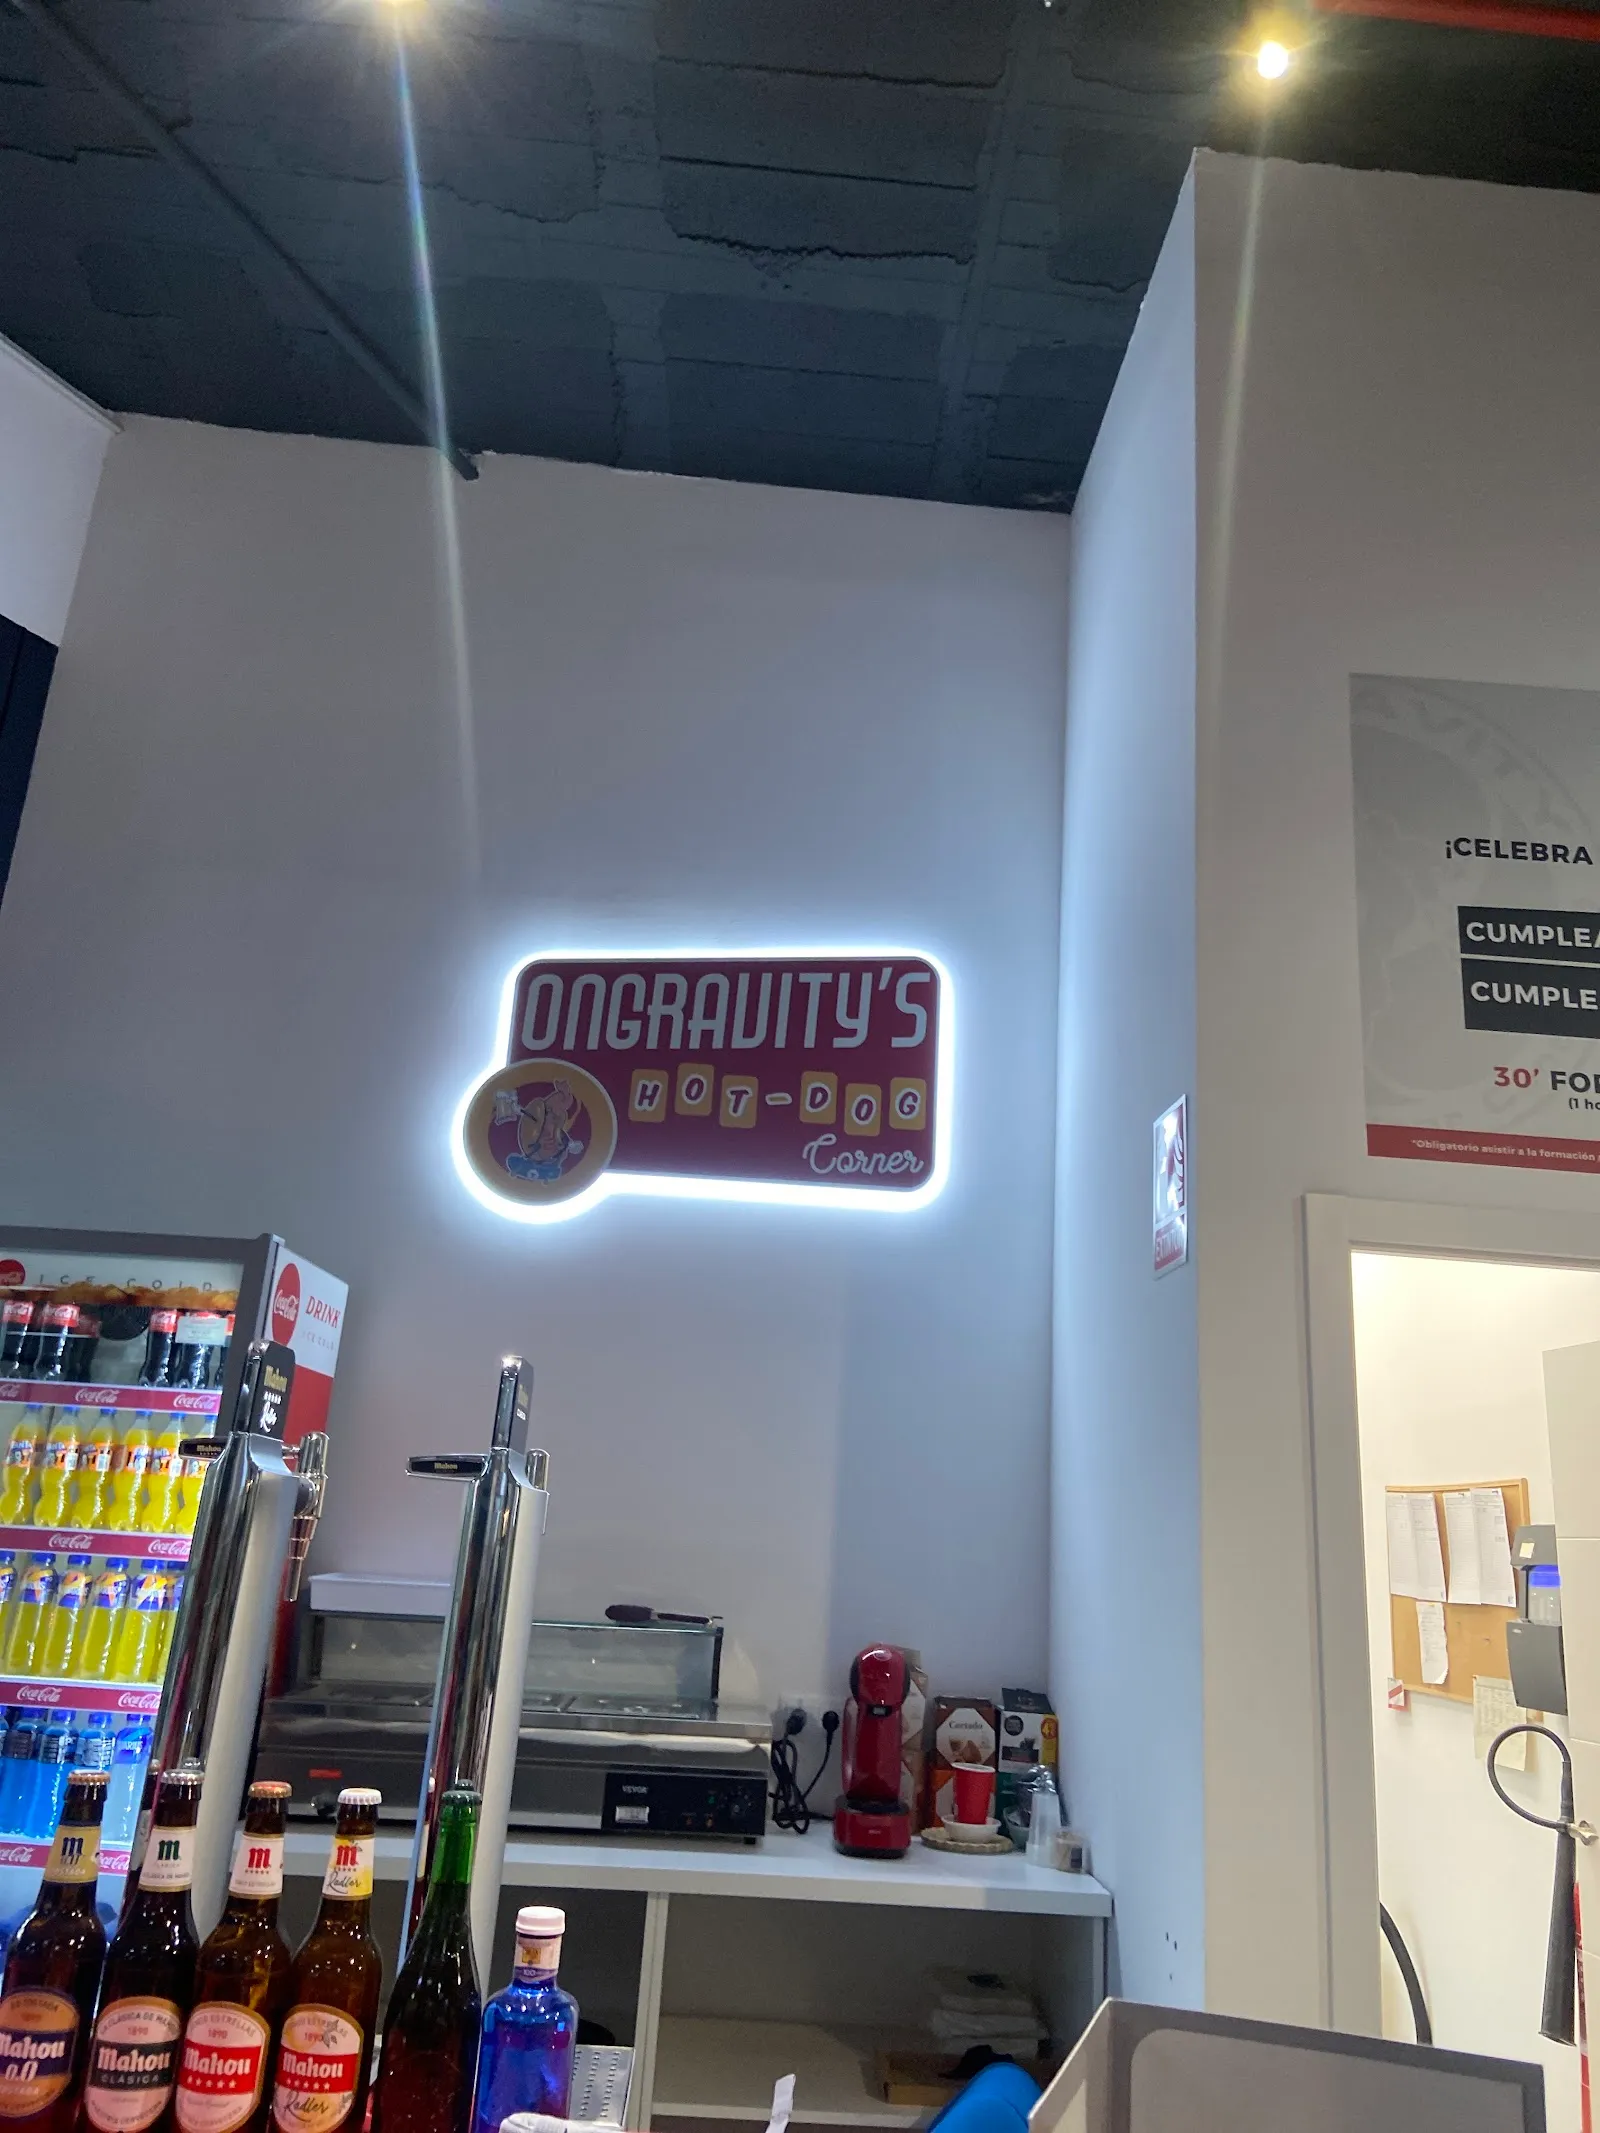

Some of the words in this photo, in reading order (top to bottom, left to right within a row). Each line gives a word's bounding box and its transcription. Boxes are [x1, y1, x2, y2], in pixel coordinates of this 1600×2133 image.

[1445, 837, 1593, 865] ¡CELEBRA
[521, 967, 931, 1050] ONGRAVITY'S
[802, 1133, 924, 1176] Corner
[305, 1295, 341, 1329] DRINK
[97, 2046, 171, 2073] Mahou
[184, 2047, 251, 2076] Mahou
[283, 2051, 343, 2079] Mahou
[283, 2088, 329, 2122] Radler
